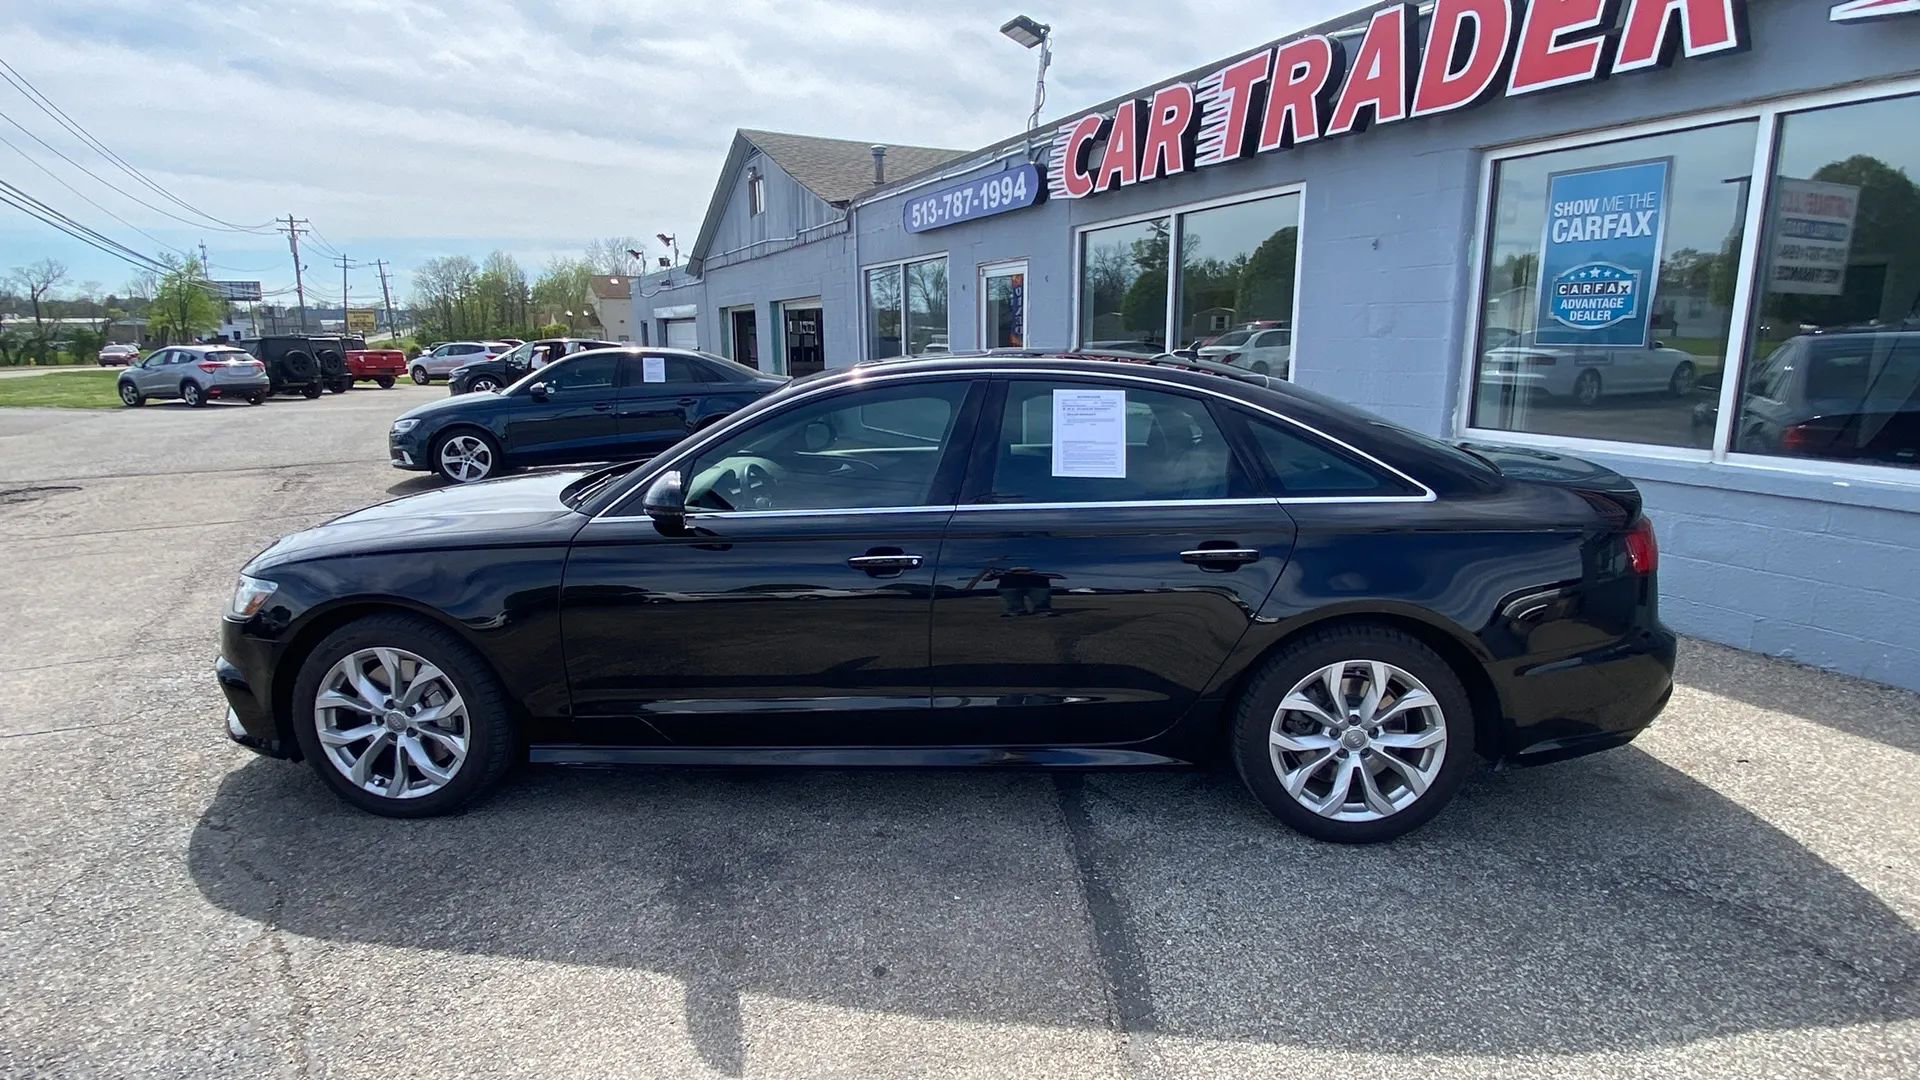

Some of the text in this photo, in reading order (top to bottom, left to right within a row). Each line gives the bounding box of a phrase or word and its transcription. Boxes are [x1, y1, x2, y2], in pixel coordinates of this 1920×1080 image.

[1050, 82, 1194, 200] CAR
[911, 170, 1028, 229] 513-787-1994
[1553, 191, 1657, 218] SHOW ME THE
[1552, 209, 1654, 244] CARFAX
[1558, 282, 1631, 295] CARFAX
[1560, 297, 1625, 310] ADVANTAGE
[1569, 309, 1612, 321] DEALER
